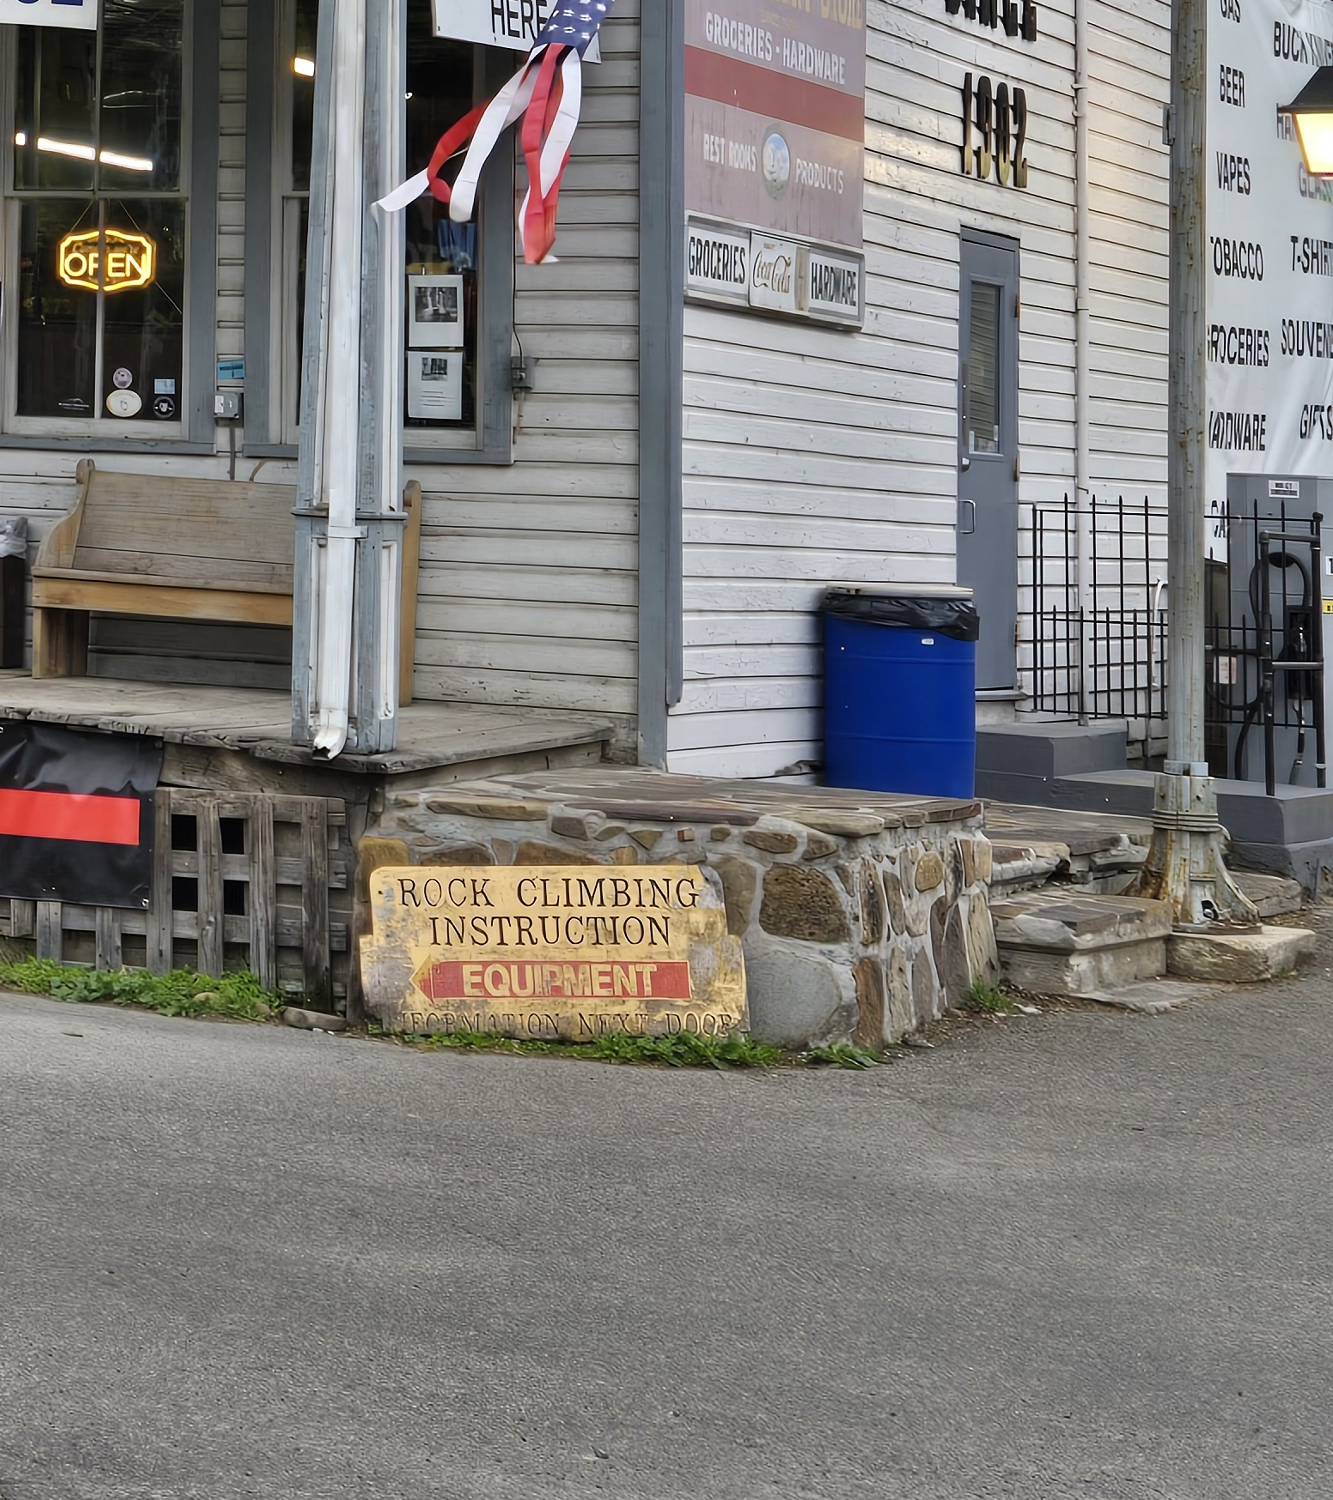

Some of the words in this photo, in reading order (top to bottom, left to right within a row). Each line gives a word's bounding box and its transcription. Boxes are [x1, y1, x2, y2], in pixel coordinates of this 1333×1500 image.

[705, 12, 772, 61] GROCERIES
[783, 37, 845, 84] HARDWARE
[1219, 65, 1245, 108] BEER
[704, 134, 725, 164] REST
[962, 73, 1027, 188] 1902
[796, 158, 843, 194] PRODUCTS
[1216, 151, 1251, 195] VAPES
[64, 252, 147, 278] OPEN
[689, 237, 745, 284] GROCERIES
[1210, 236, 1263, 281] OBACCO
[811, 262, 856, 306] HARDWARE
[1207, 324, 1269, 367] ROCERIES
[398, 878, 495, 908] ROCK
[517, 876, 700, 909] CLIMBING
[430, 916, 671, 946] INSTRUCTION
[463, 964, 658, 997] EQUIPMENT
